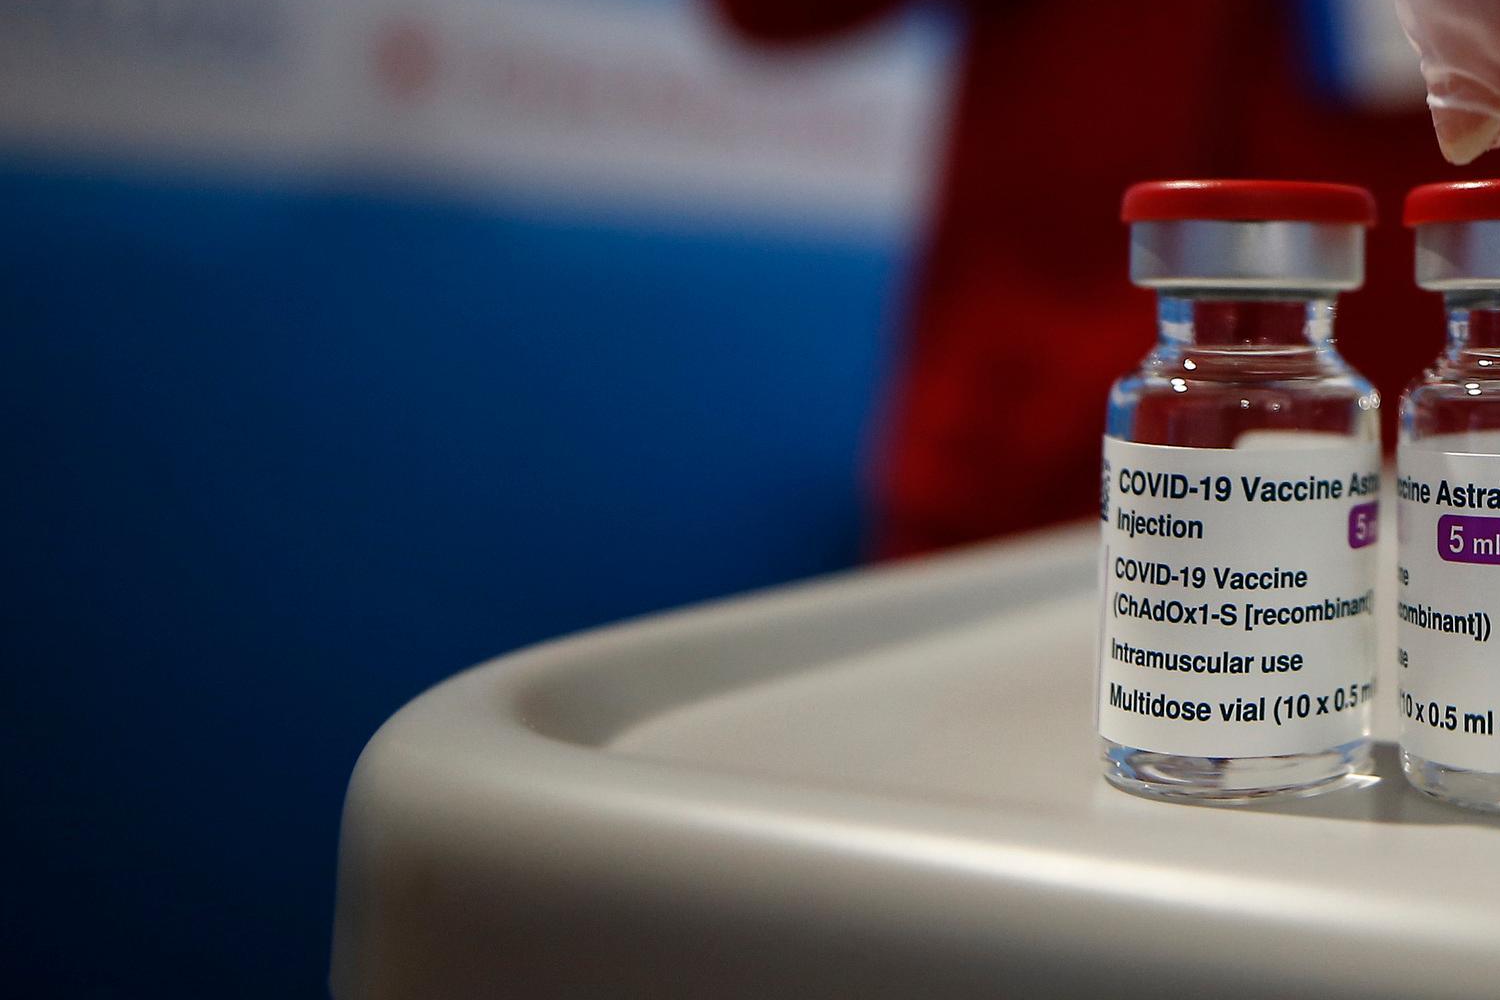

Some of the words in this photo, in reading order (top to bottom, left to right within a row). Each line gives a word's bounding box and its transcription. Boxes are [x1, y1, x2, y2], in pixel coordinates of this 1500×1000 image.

[1119, 468, 1232, 502] COVID-19
[1241, 475, 1343, 502] Vaccine
[1117, 507, 1204, 540] Injection
[1449, 525, 1465, 554] 5
[1473, 533, 1500, 556] ml
[1115, 557, 1206, 589] COVID-19
[1214, 567, 1308, 590] Vaccine
[1113, 592, 1238, 627] (ChAdOx1-S
[1111, 637, 1255, 674] Intramuscular
[1261, 652, 1304, 673] use
[1109, 682, 1212, 722] Multidose
[1219, 697, 1266, 722] vial
[1273, 693, 1310, 726] (10
[1316, 695, 1329, 716] x
[1334, 684, 1358, 713] 0.5
[1415, 702, 1425, 724] x
[1428, 701, 1458, 732] 0.5
[1464, 710, 1494, 736] ml
